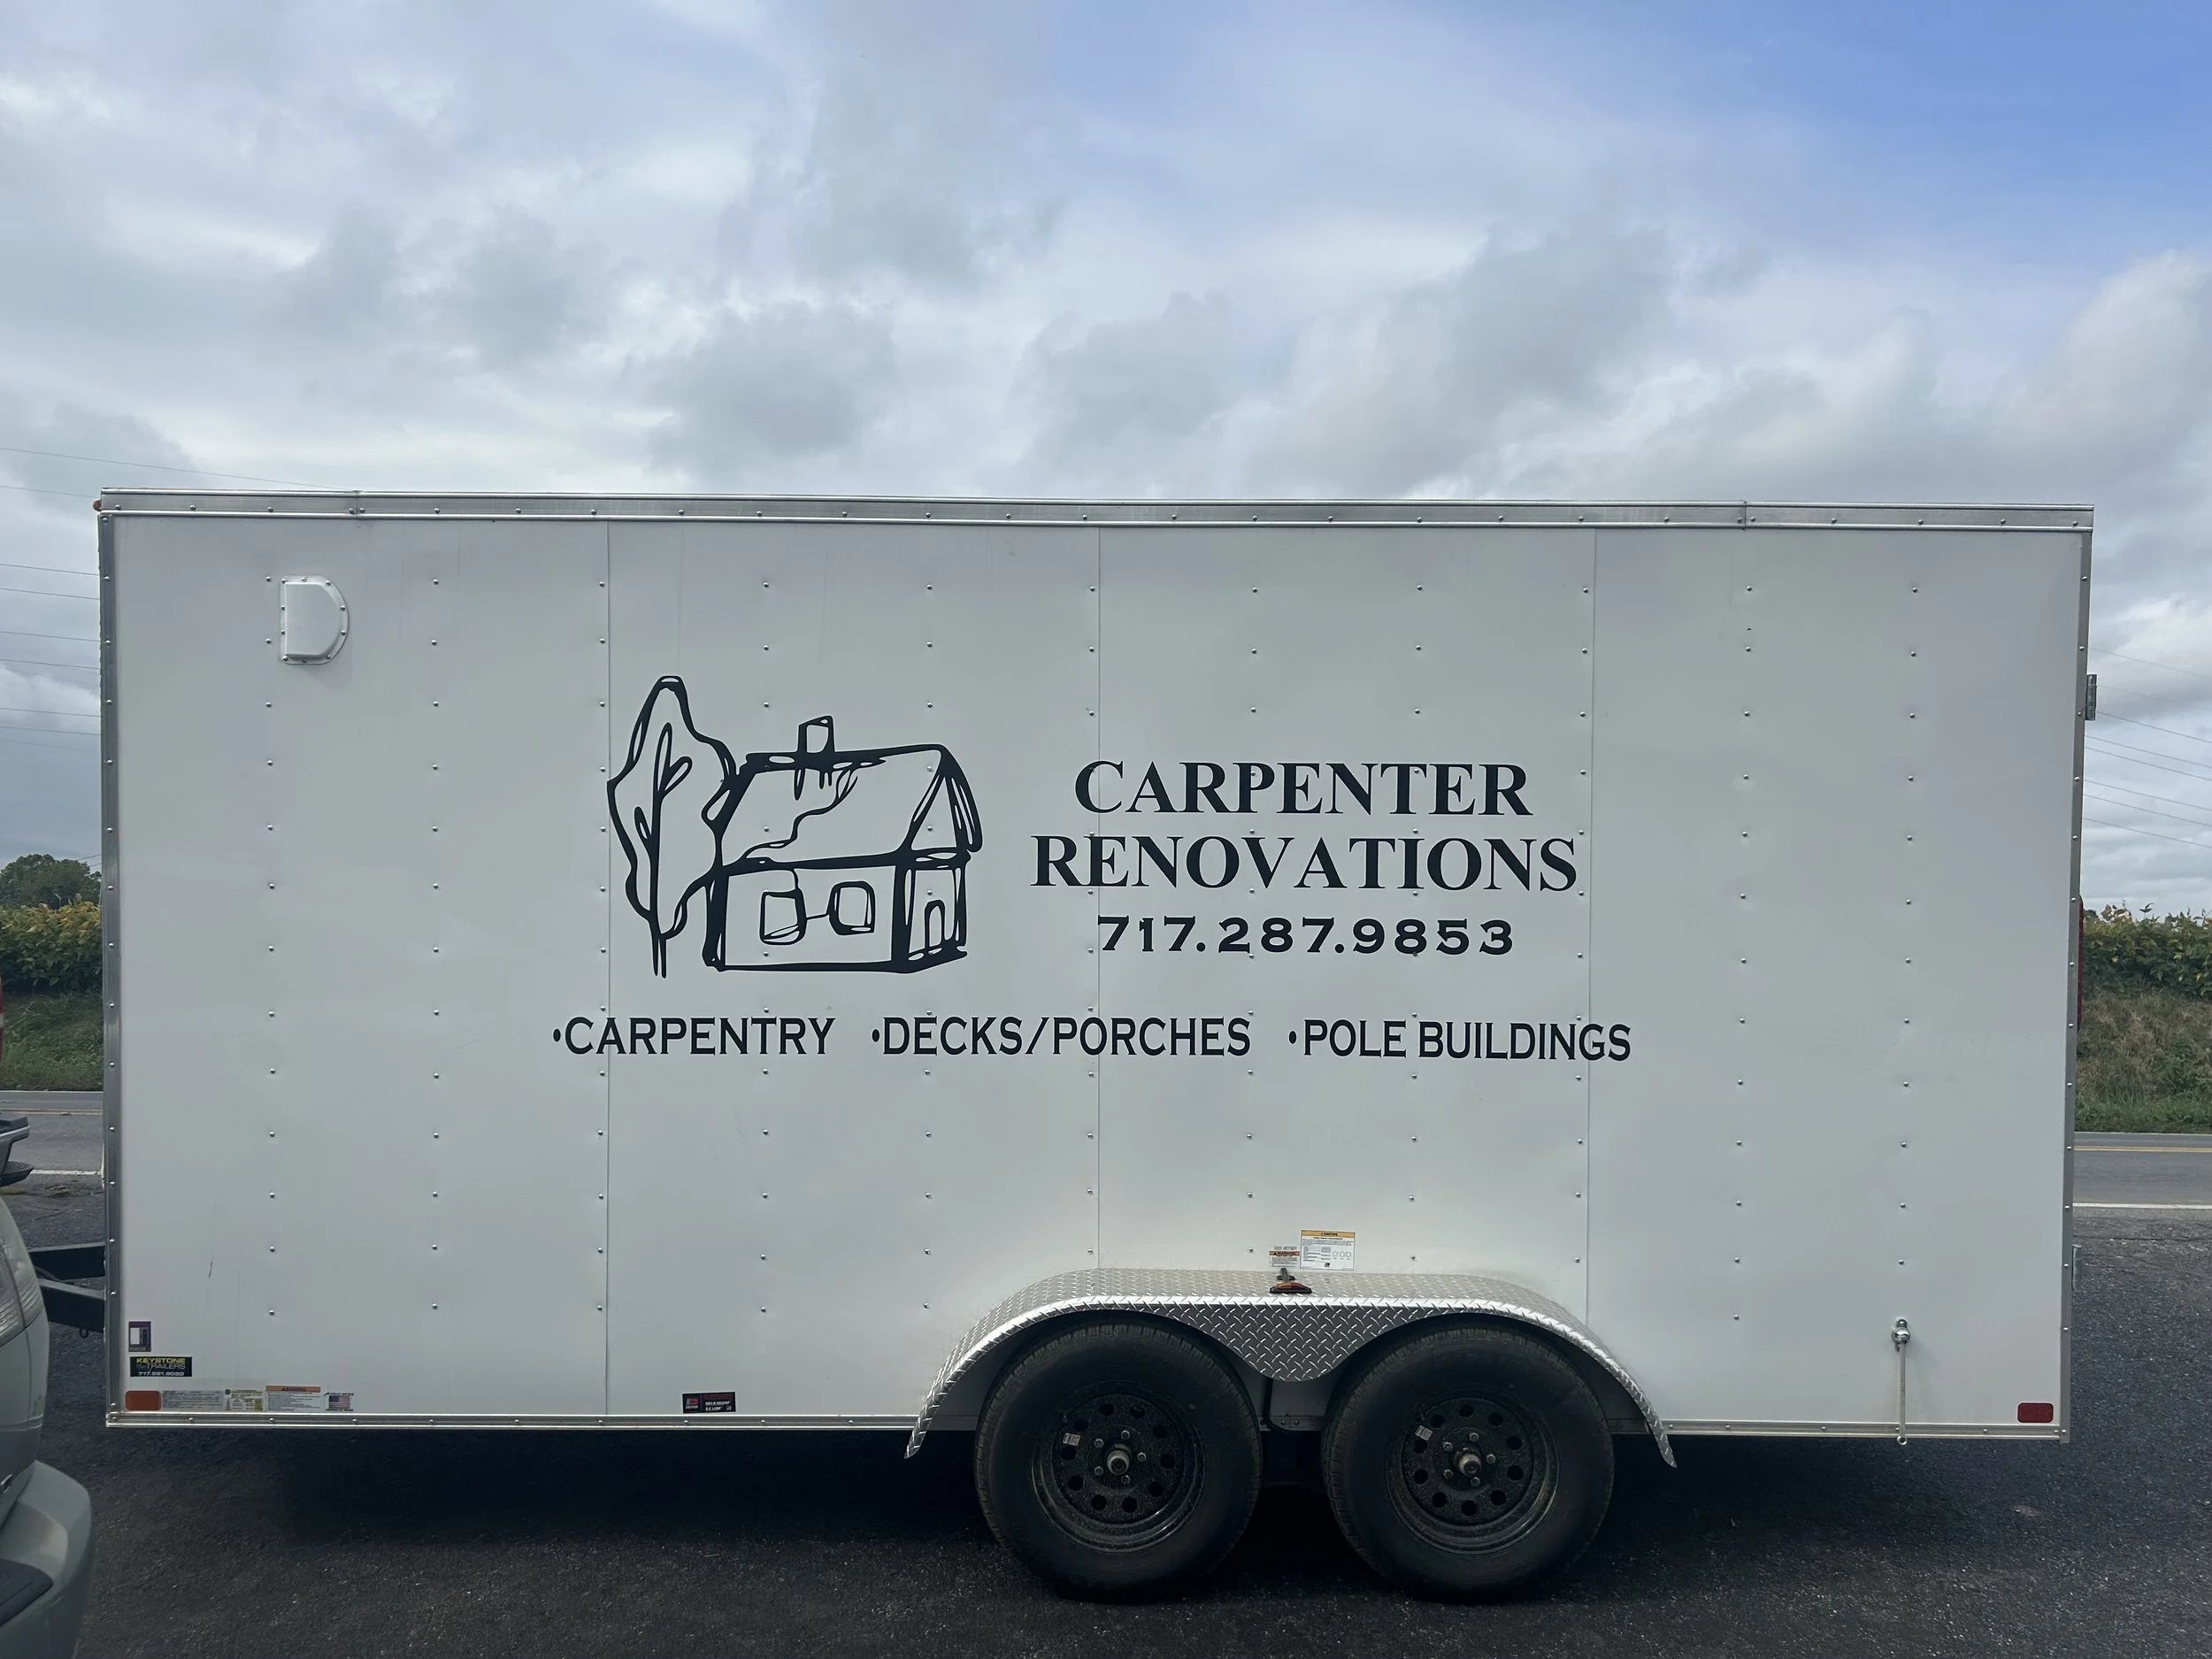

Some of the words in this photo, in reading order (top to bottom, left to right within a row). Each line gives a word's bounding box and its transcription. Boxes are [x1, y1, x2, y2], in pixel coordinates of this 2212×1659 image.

[1075, 761, 1533, 816] CARPENTER
[1031, 834, 1578, 892] RENOVATIONS
[1098, 916, 1514, 956] 717.287.9853
[1419, 1021, 1632, 1062] BUILDINGS
